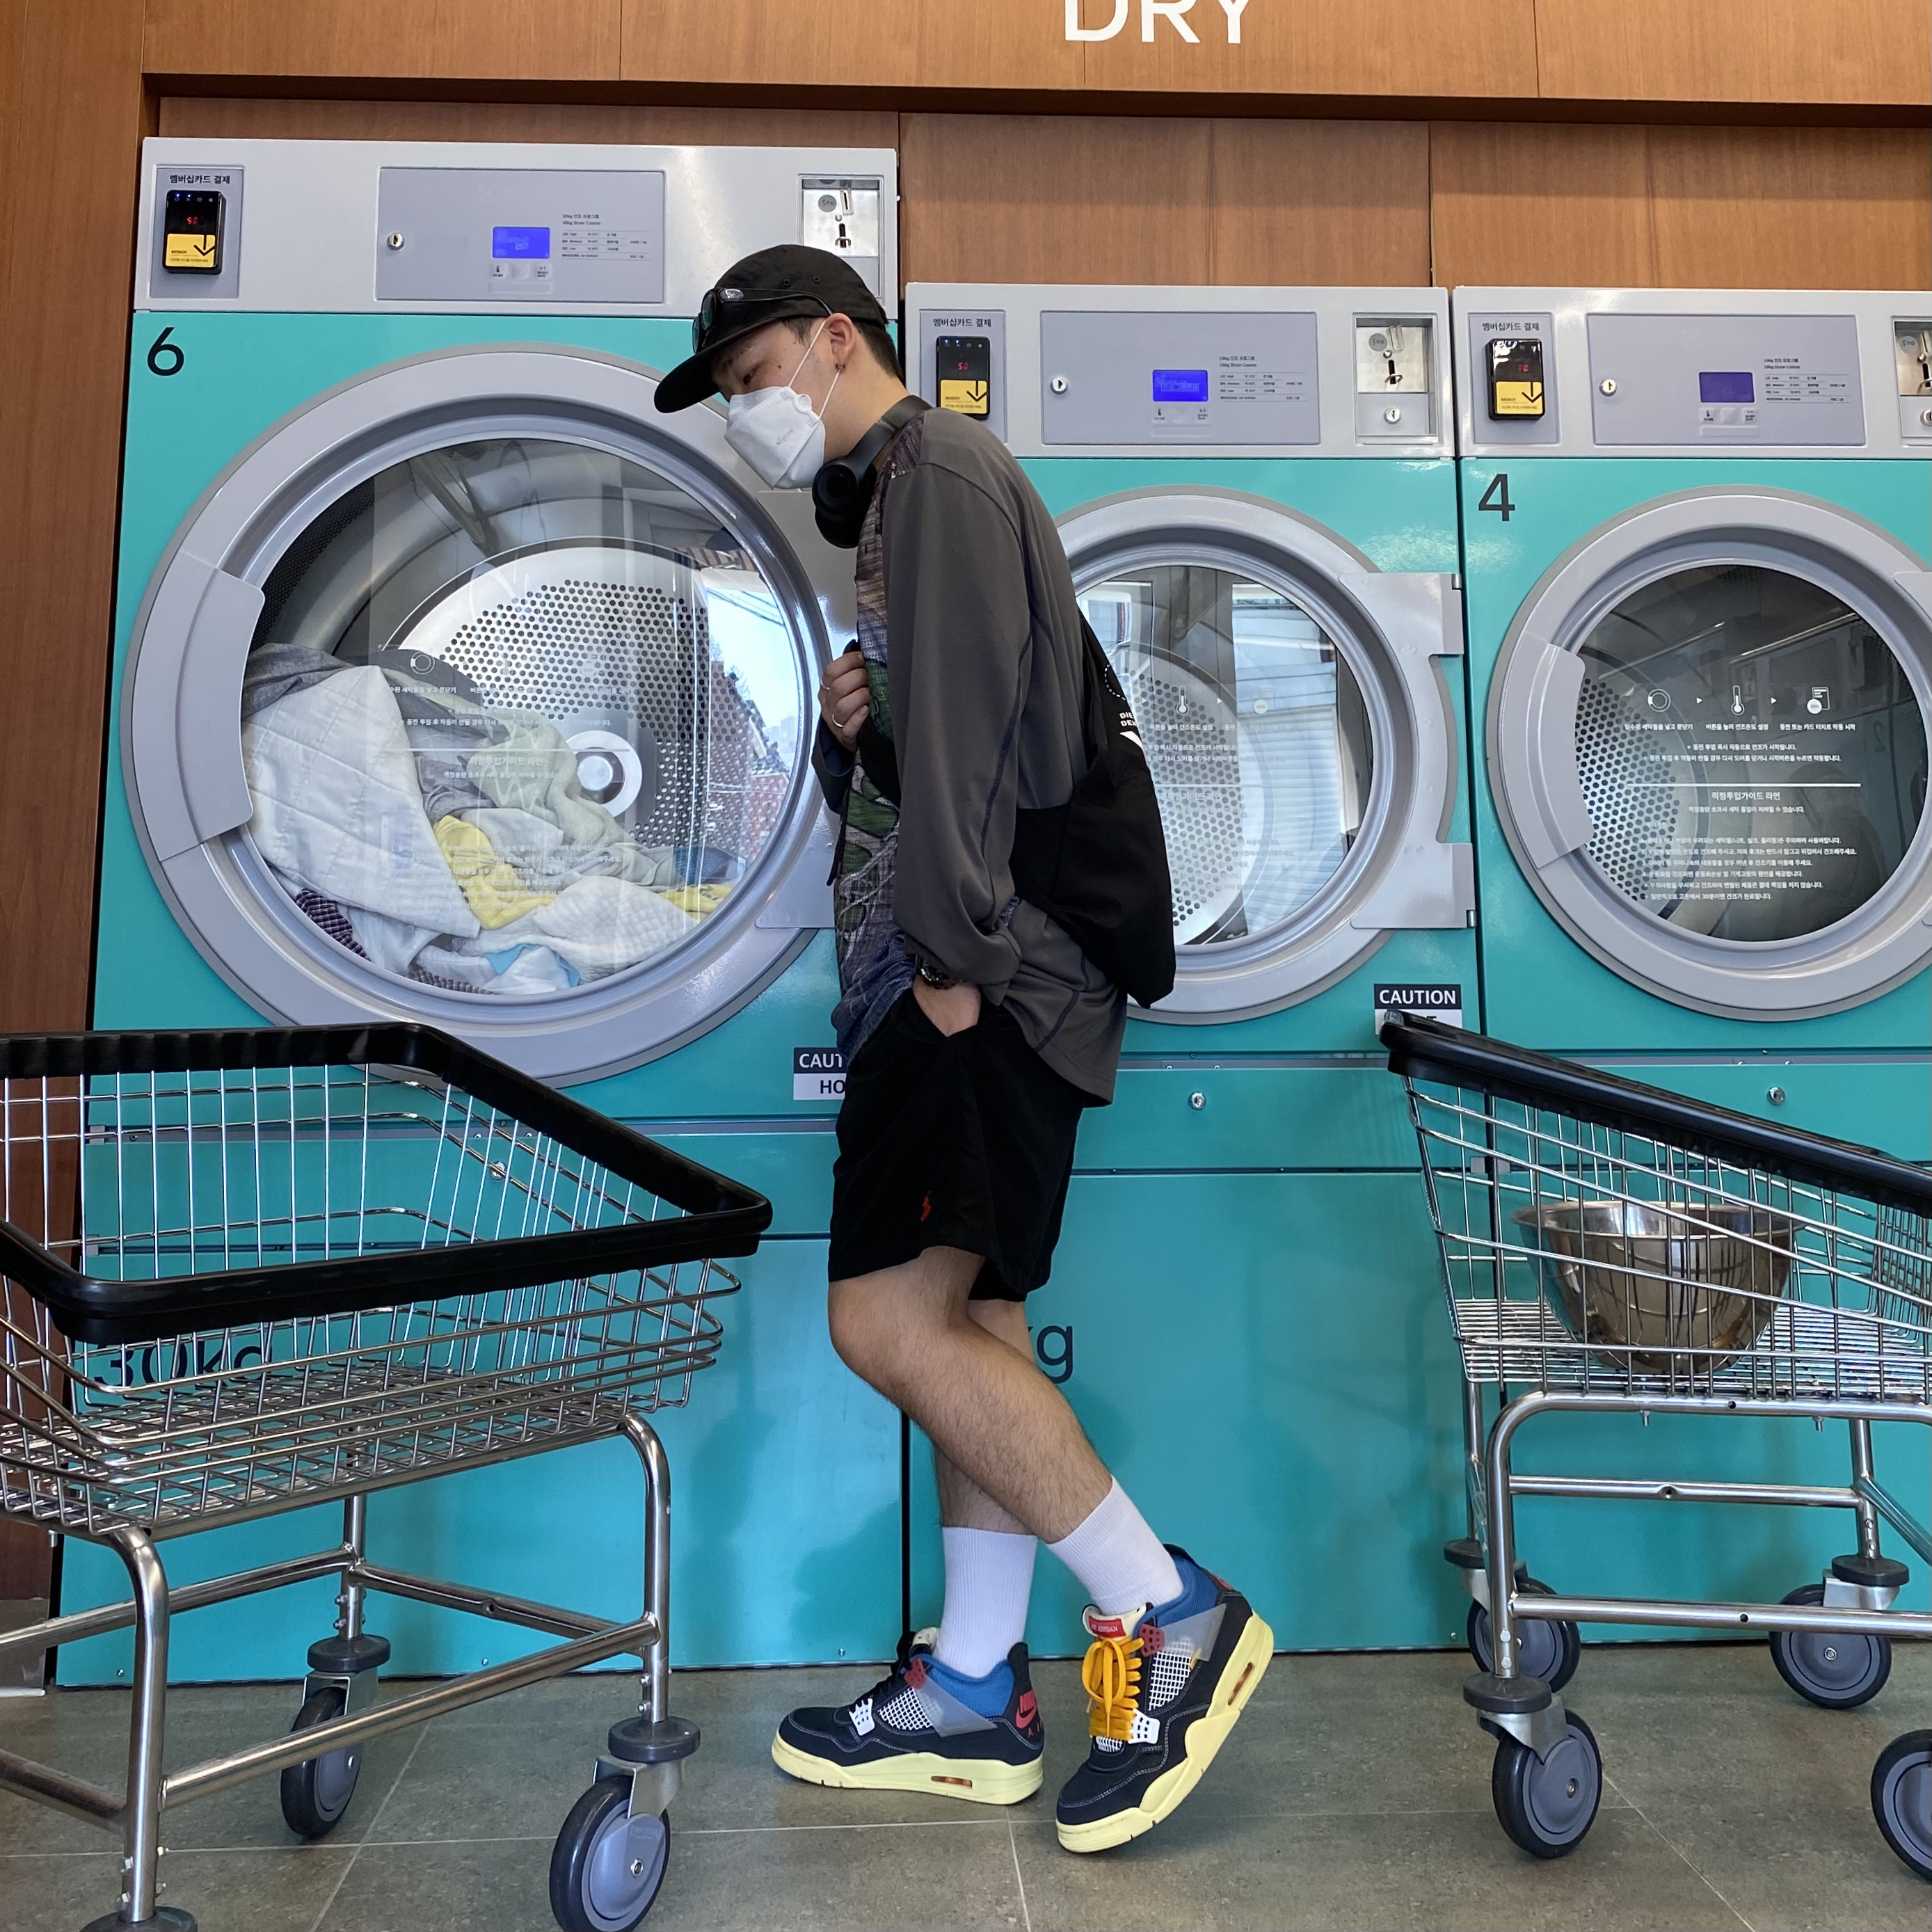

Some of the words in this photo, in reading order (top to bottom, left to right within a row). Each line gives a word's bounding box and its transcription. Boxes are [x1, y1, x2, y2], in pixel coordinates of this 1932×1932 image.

[1064, 0, 1250, 43] DRY
[170, 175, 211, 184] 멤버십카드
[214, 175, 230, 184] 결제
[933, 319, 973, 327] 멤버십카드
[975, 319, 991, 327] 결제
[1482, 323, 1522, 331] 멤버십카드
[1524, 323, 1540, 331] 결제
[147, 327, 184, 376] 6
[1478, 473, 1515, 522] 4
[1711, 792, 1764, 801] 적정투입가이드
[1765, 792, 1780, 801] 라인
[1379, 989, 1456, 1005] CAUTION
